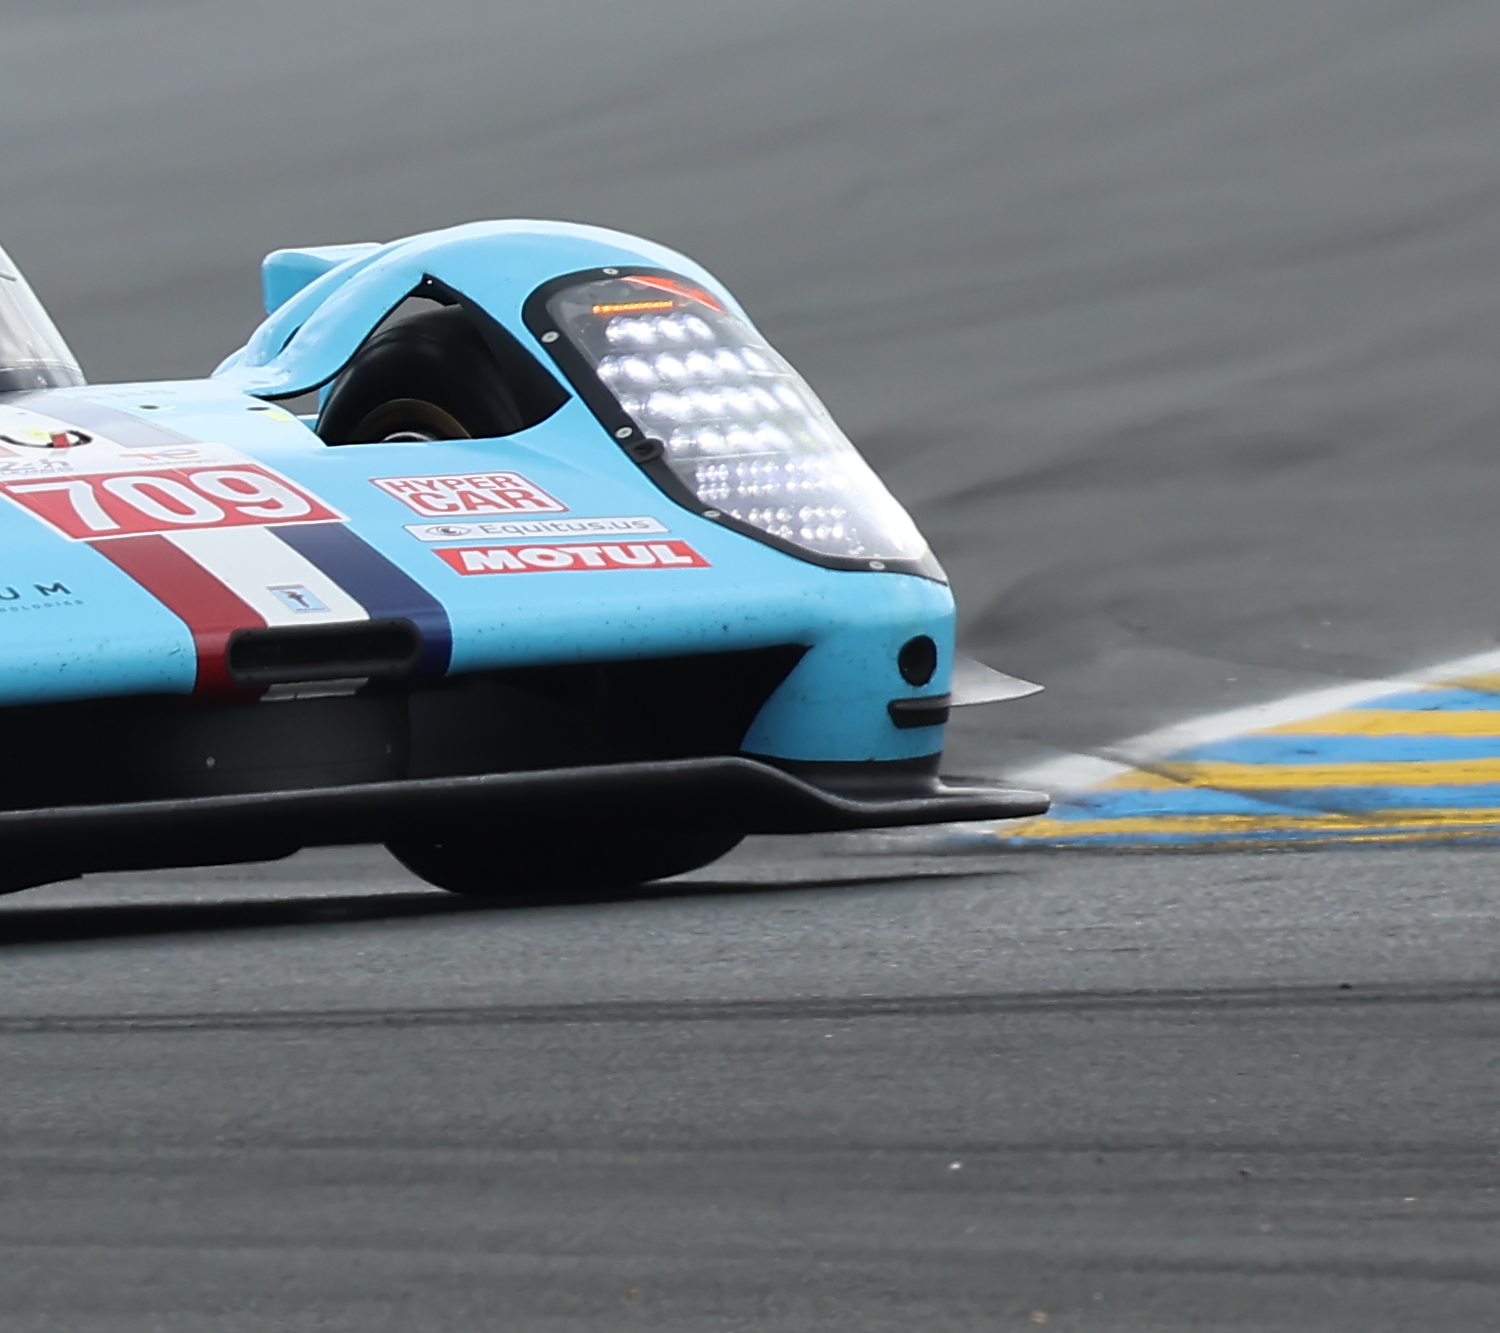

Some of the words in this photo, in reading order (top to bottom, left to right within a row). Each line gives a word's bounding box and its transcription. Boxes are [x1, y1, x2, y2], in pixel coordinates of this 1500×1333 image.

[385, 475, 524, 493] HYPER
[6, 470, 312, 531] 709
[407, 489, 546, 512] CAR
[477, 519, 650, 535] Equitus.us
[459, 544, 693, 572] MOTUL
